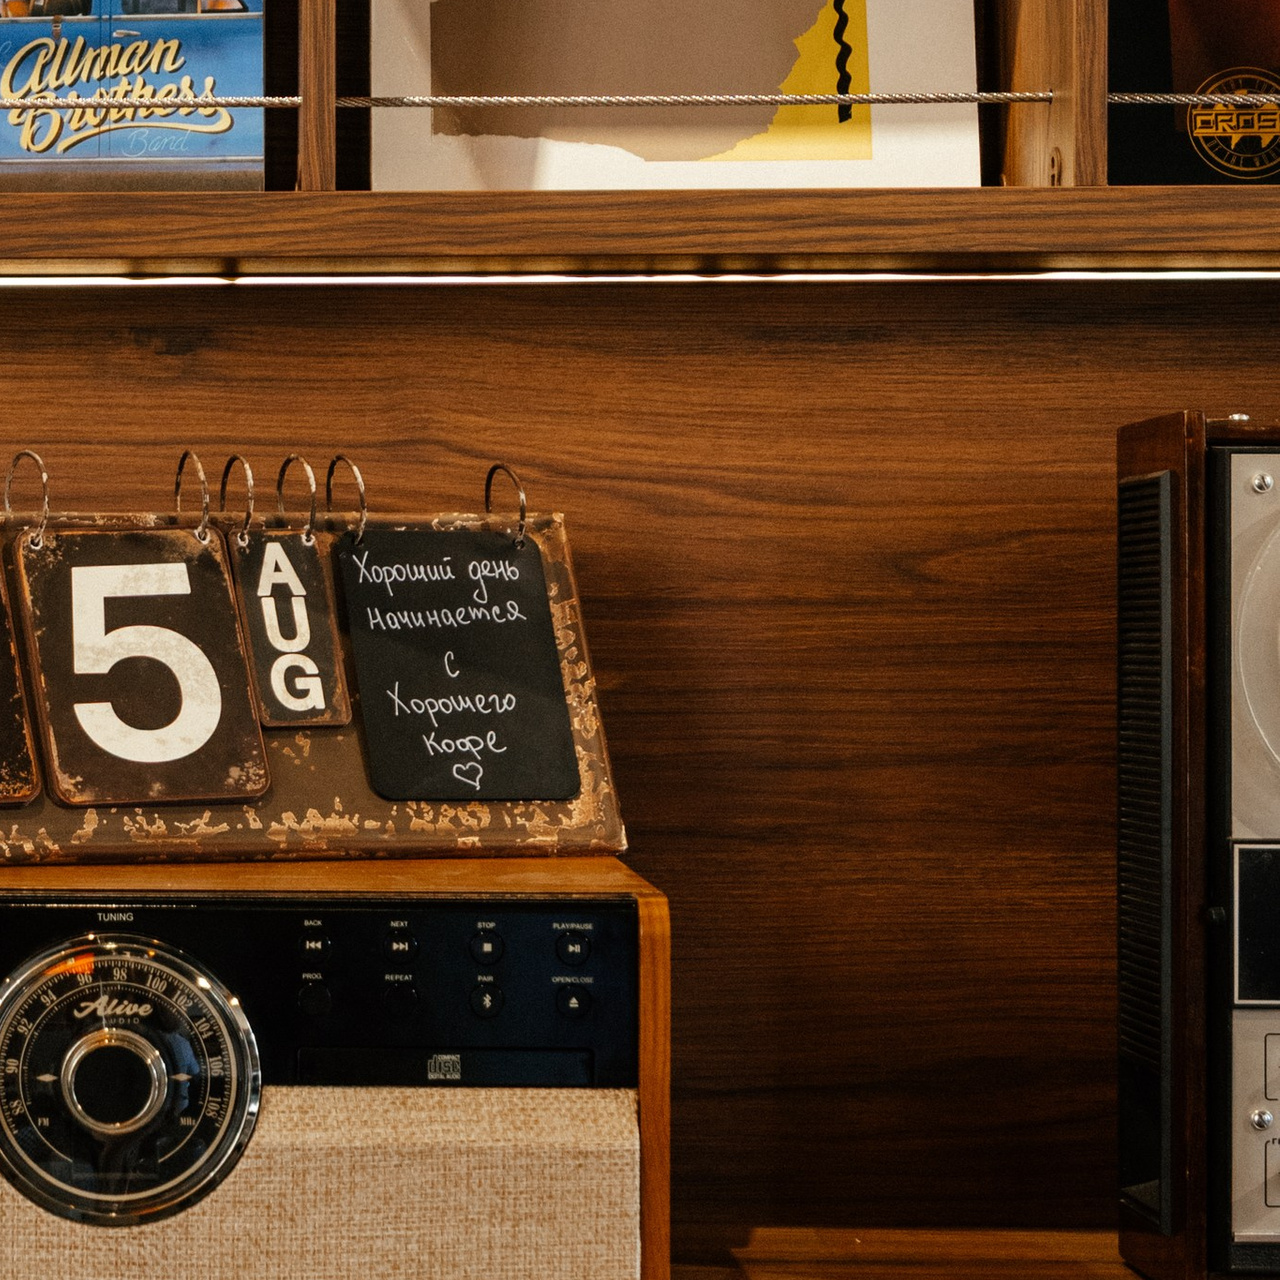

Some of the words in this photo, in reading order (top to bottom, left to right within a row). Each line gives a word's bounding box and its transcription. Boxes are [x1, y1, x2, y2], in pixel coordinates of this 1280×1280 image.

[0, 35, 185, 100] Allman
[8, 75, 233, 153] Brothers
[121, 130, 190, 156] Band
[352, 551, 455, 596] Хороший
[469, 560, 519, 603] день
[367, 601, 527, 630] Начинается
[257, 542, 326, 711] AUG
[387, 682, 516, 727] Хорошего
[97, 913, 134, 921] TUNING
[77, 971, 93, 986] 96
[113, 967, 128, 981] 98
[146, 974, 167, 993] 100
[39, 989, 57, 1007] 94
[73, 995, 153, 1018] Alive
[172, 989, 193, 1008] 102
[16, 1017, 34, 1036] 92
[195, 1017, 213, 1040] 104
[5, 1058, 19, 1074] 90
[209, 1055, 224, 1077] 106
[9, 1099, 25, 1115] 88
[205, 1096, 223, 1118] 108
[38, 1117, 49, 1127] FM
[180, 1117, 197, 1126] MHz
